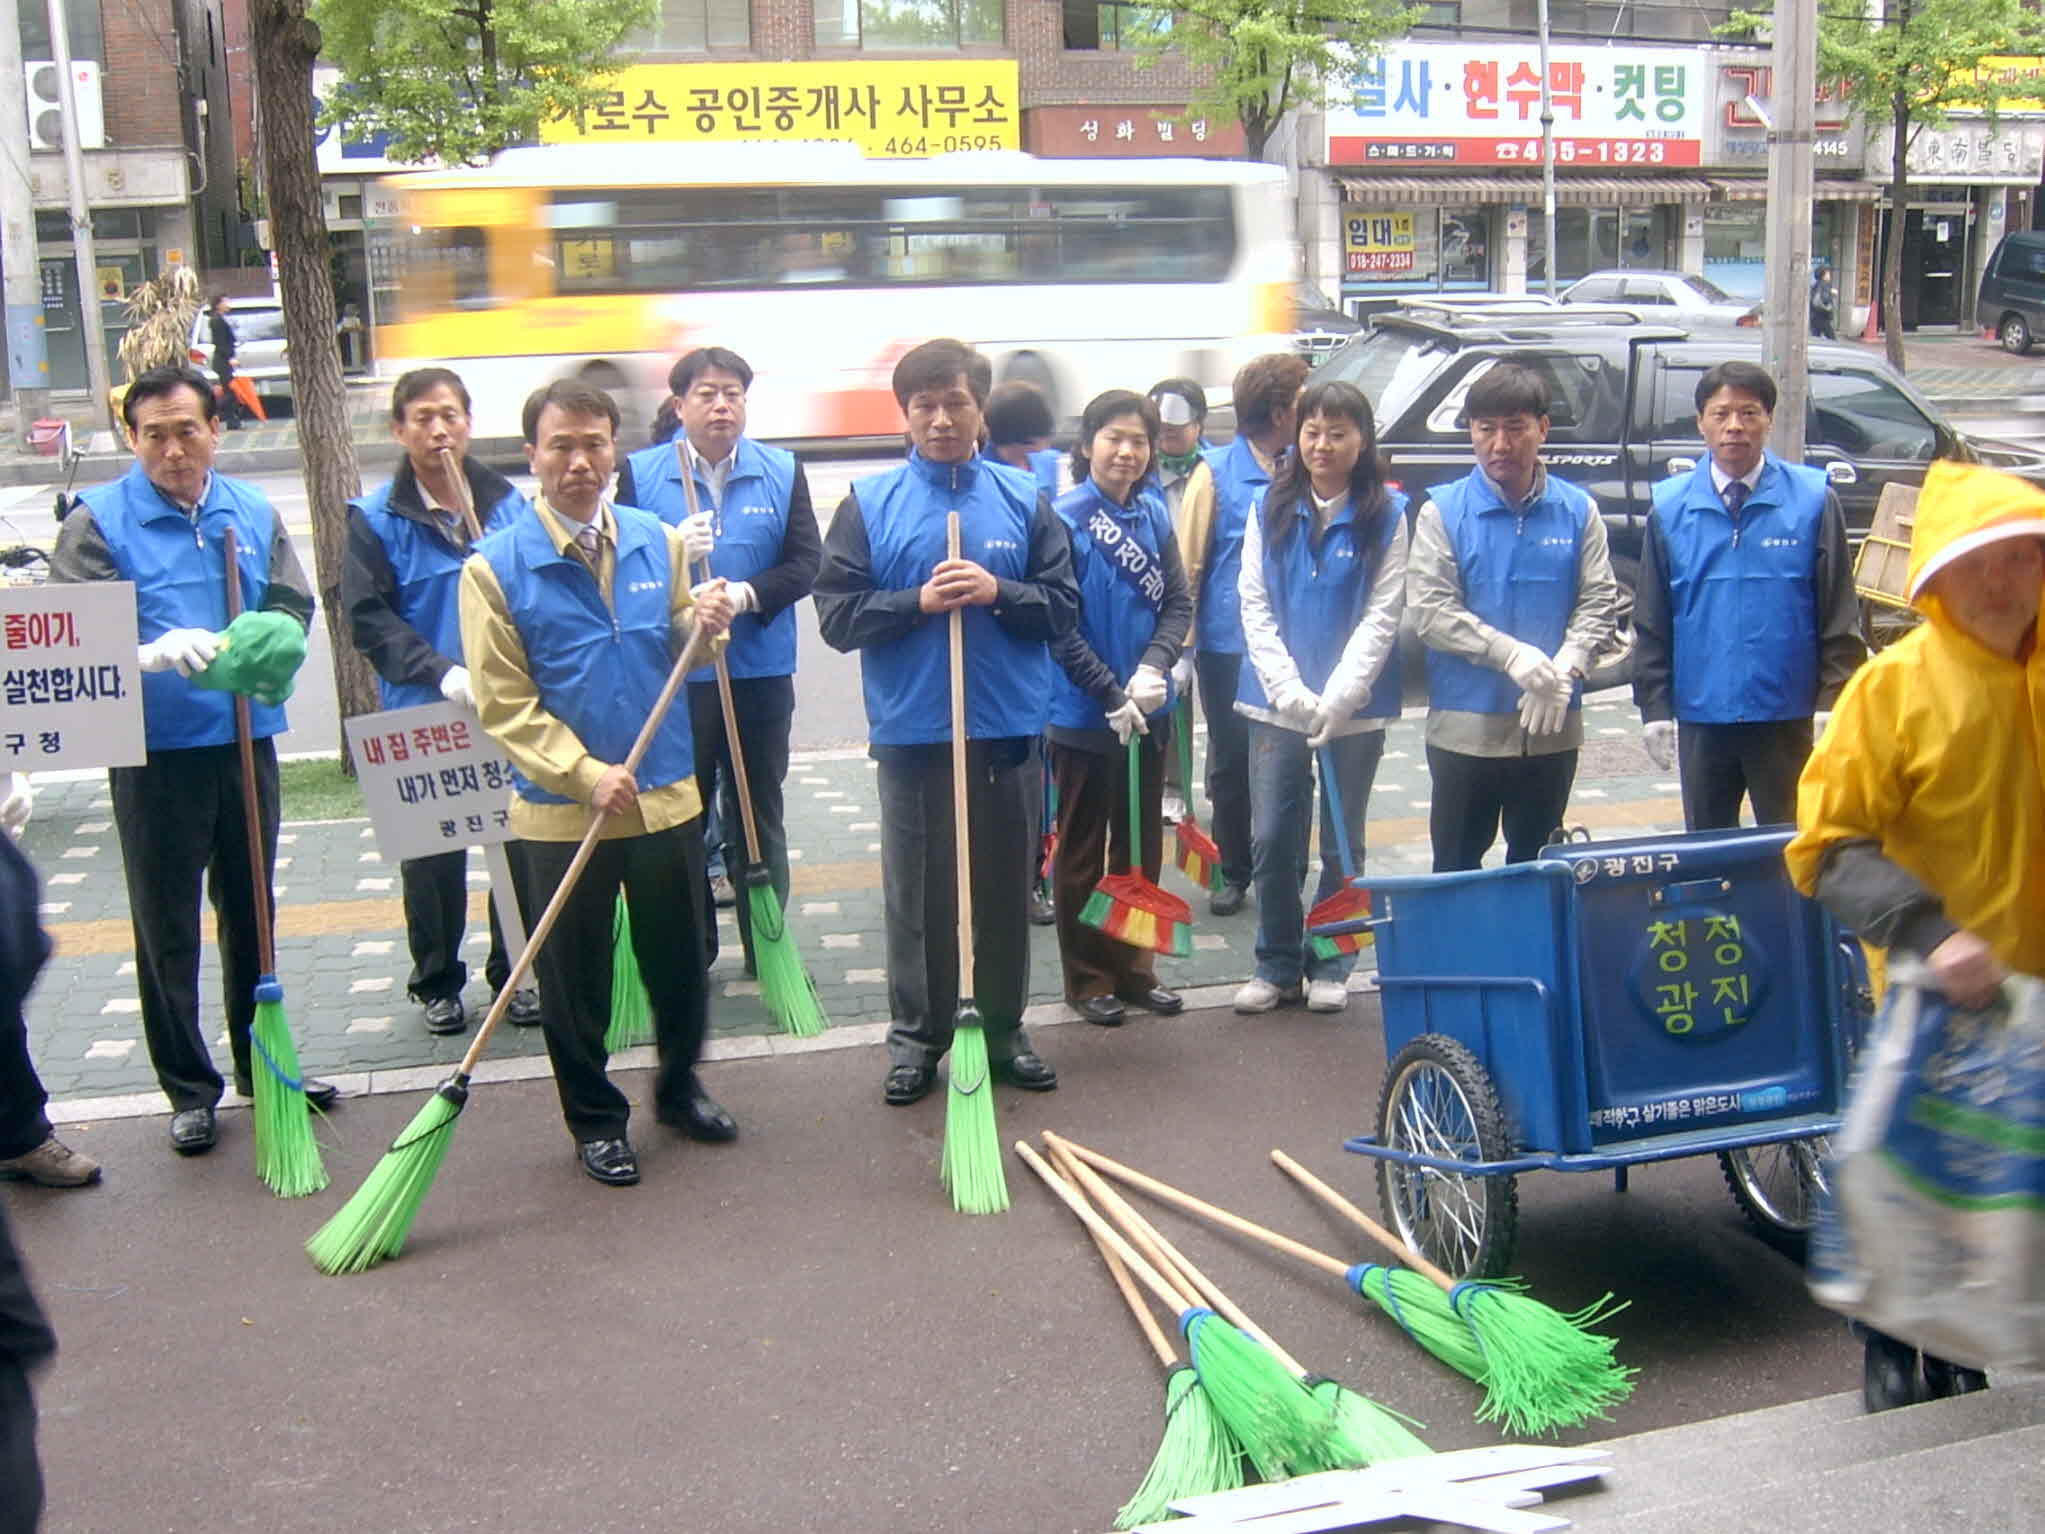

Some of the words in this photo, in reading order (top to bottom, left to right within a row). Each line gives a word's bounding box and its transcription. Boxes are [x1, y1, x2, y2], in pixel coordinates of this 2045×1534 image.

[686, 85, 880, 133] 공인중개사
[896, 84, 1008, 126] 사무소
[1613, 63, 1685, 123] 컷팅
[1523, 140, 1664, 163] 45-1323
[3, 665, 127, 706] 실천합시다.
[396, 772, 438, 804] 내가
[439, 763, 480, 797] 먼저
